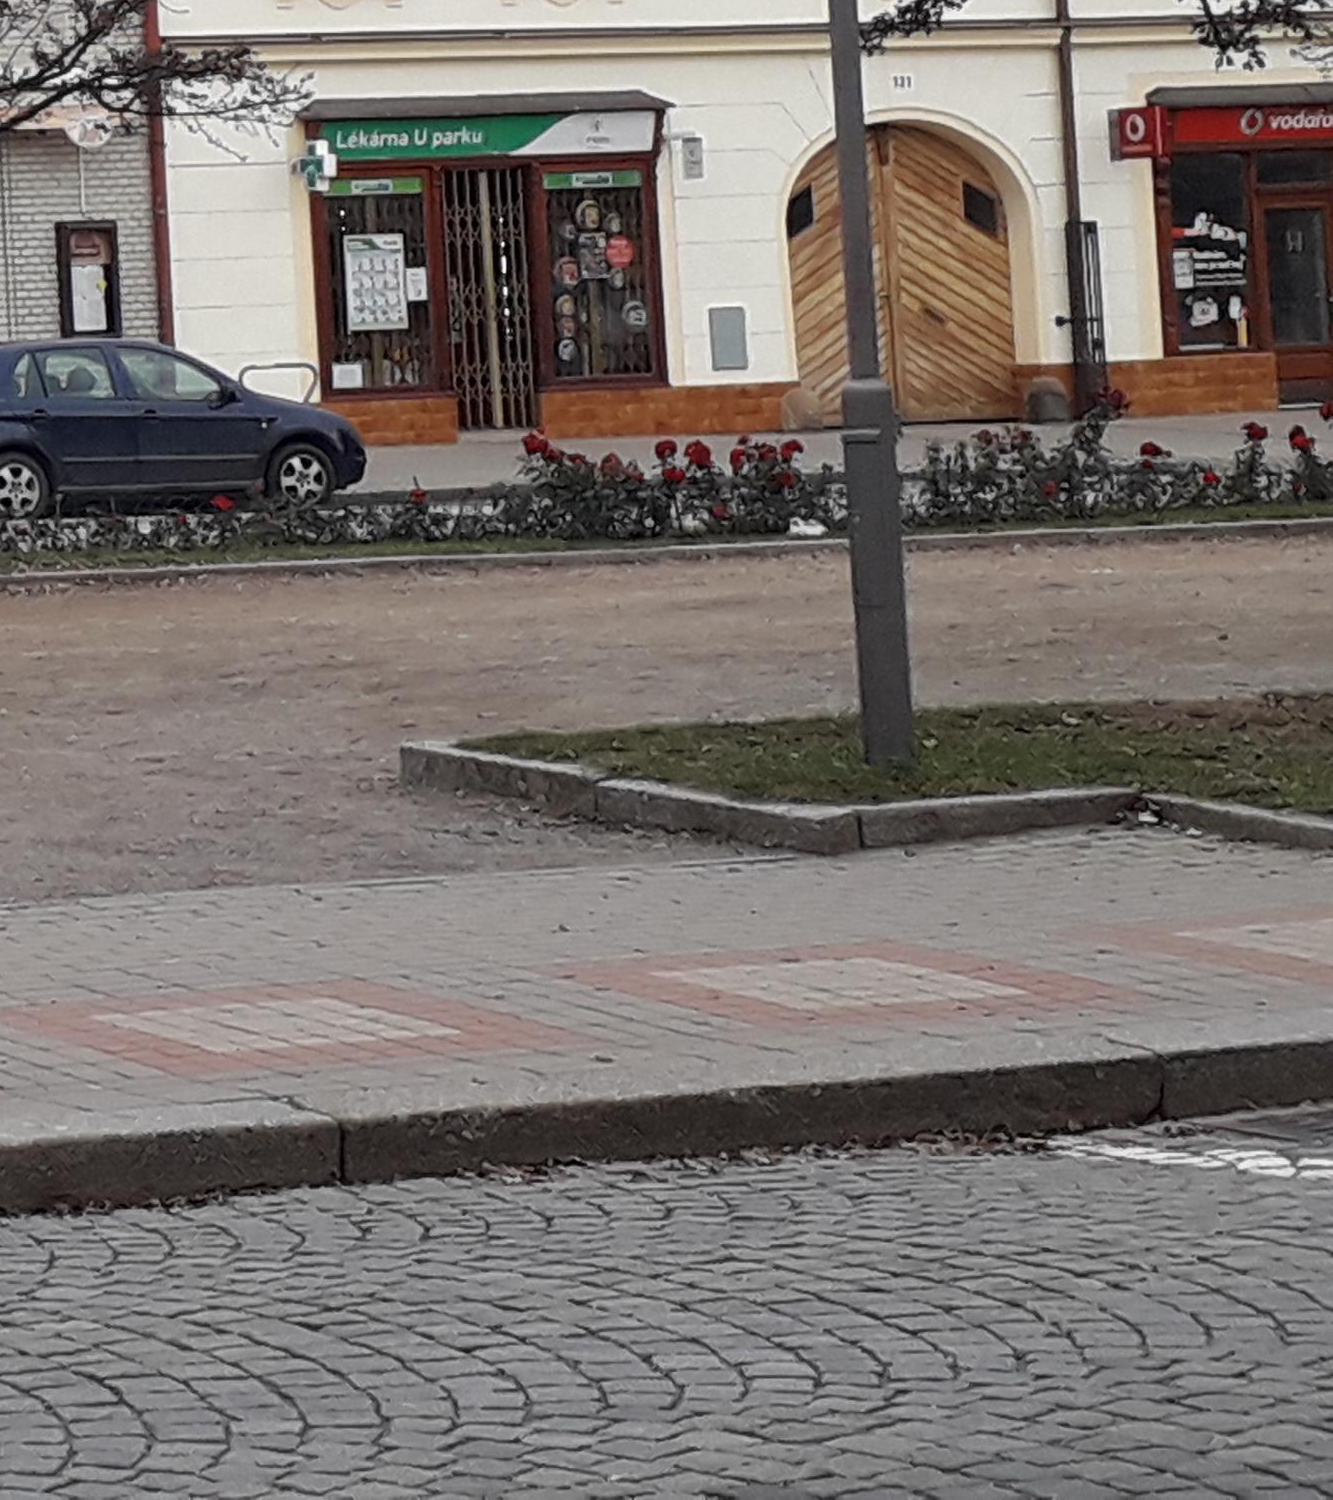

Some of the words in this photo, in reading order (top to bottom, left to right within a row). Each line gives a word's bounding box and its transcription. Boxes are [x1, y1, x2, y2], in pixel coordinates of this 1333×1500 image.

[336, 128, 410, 149] Lékárna
[413, 127, 428, 146] U
[432, 125, 483, 149] parku
